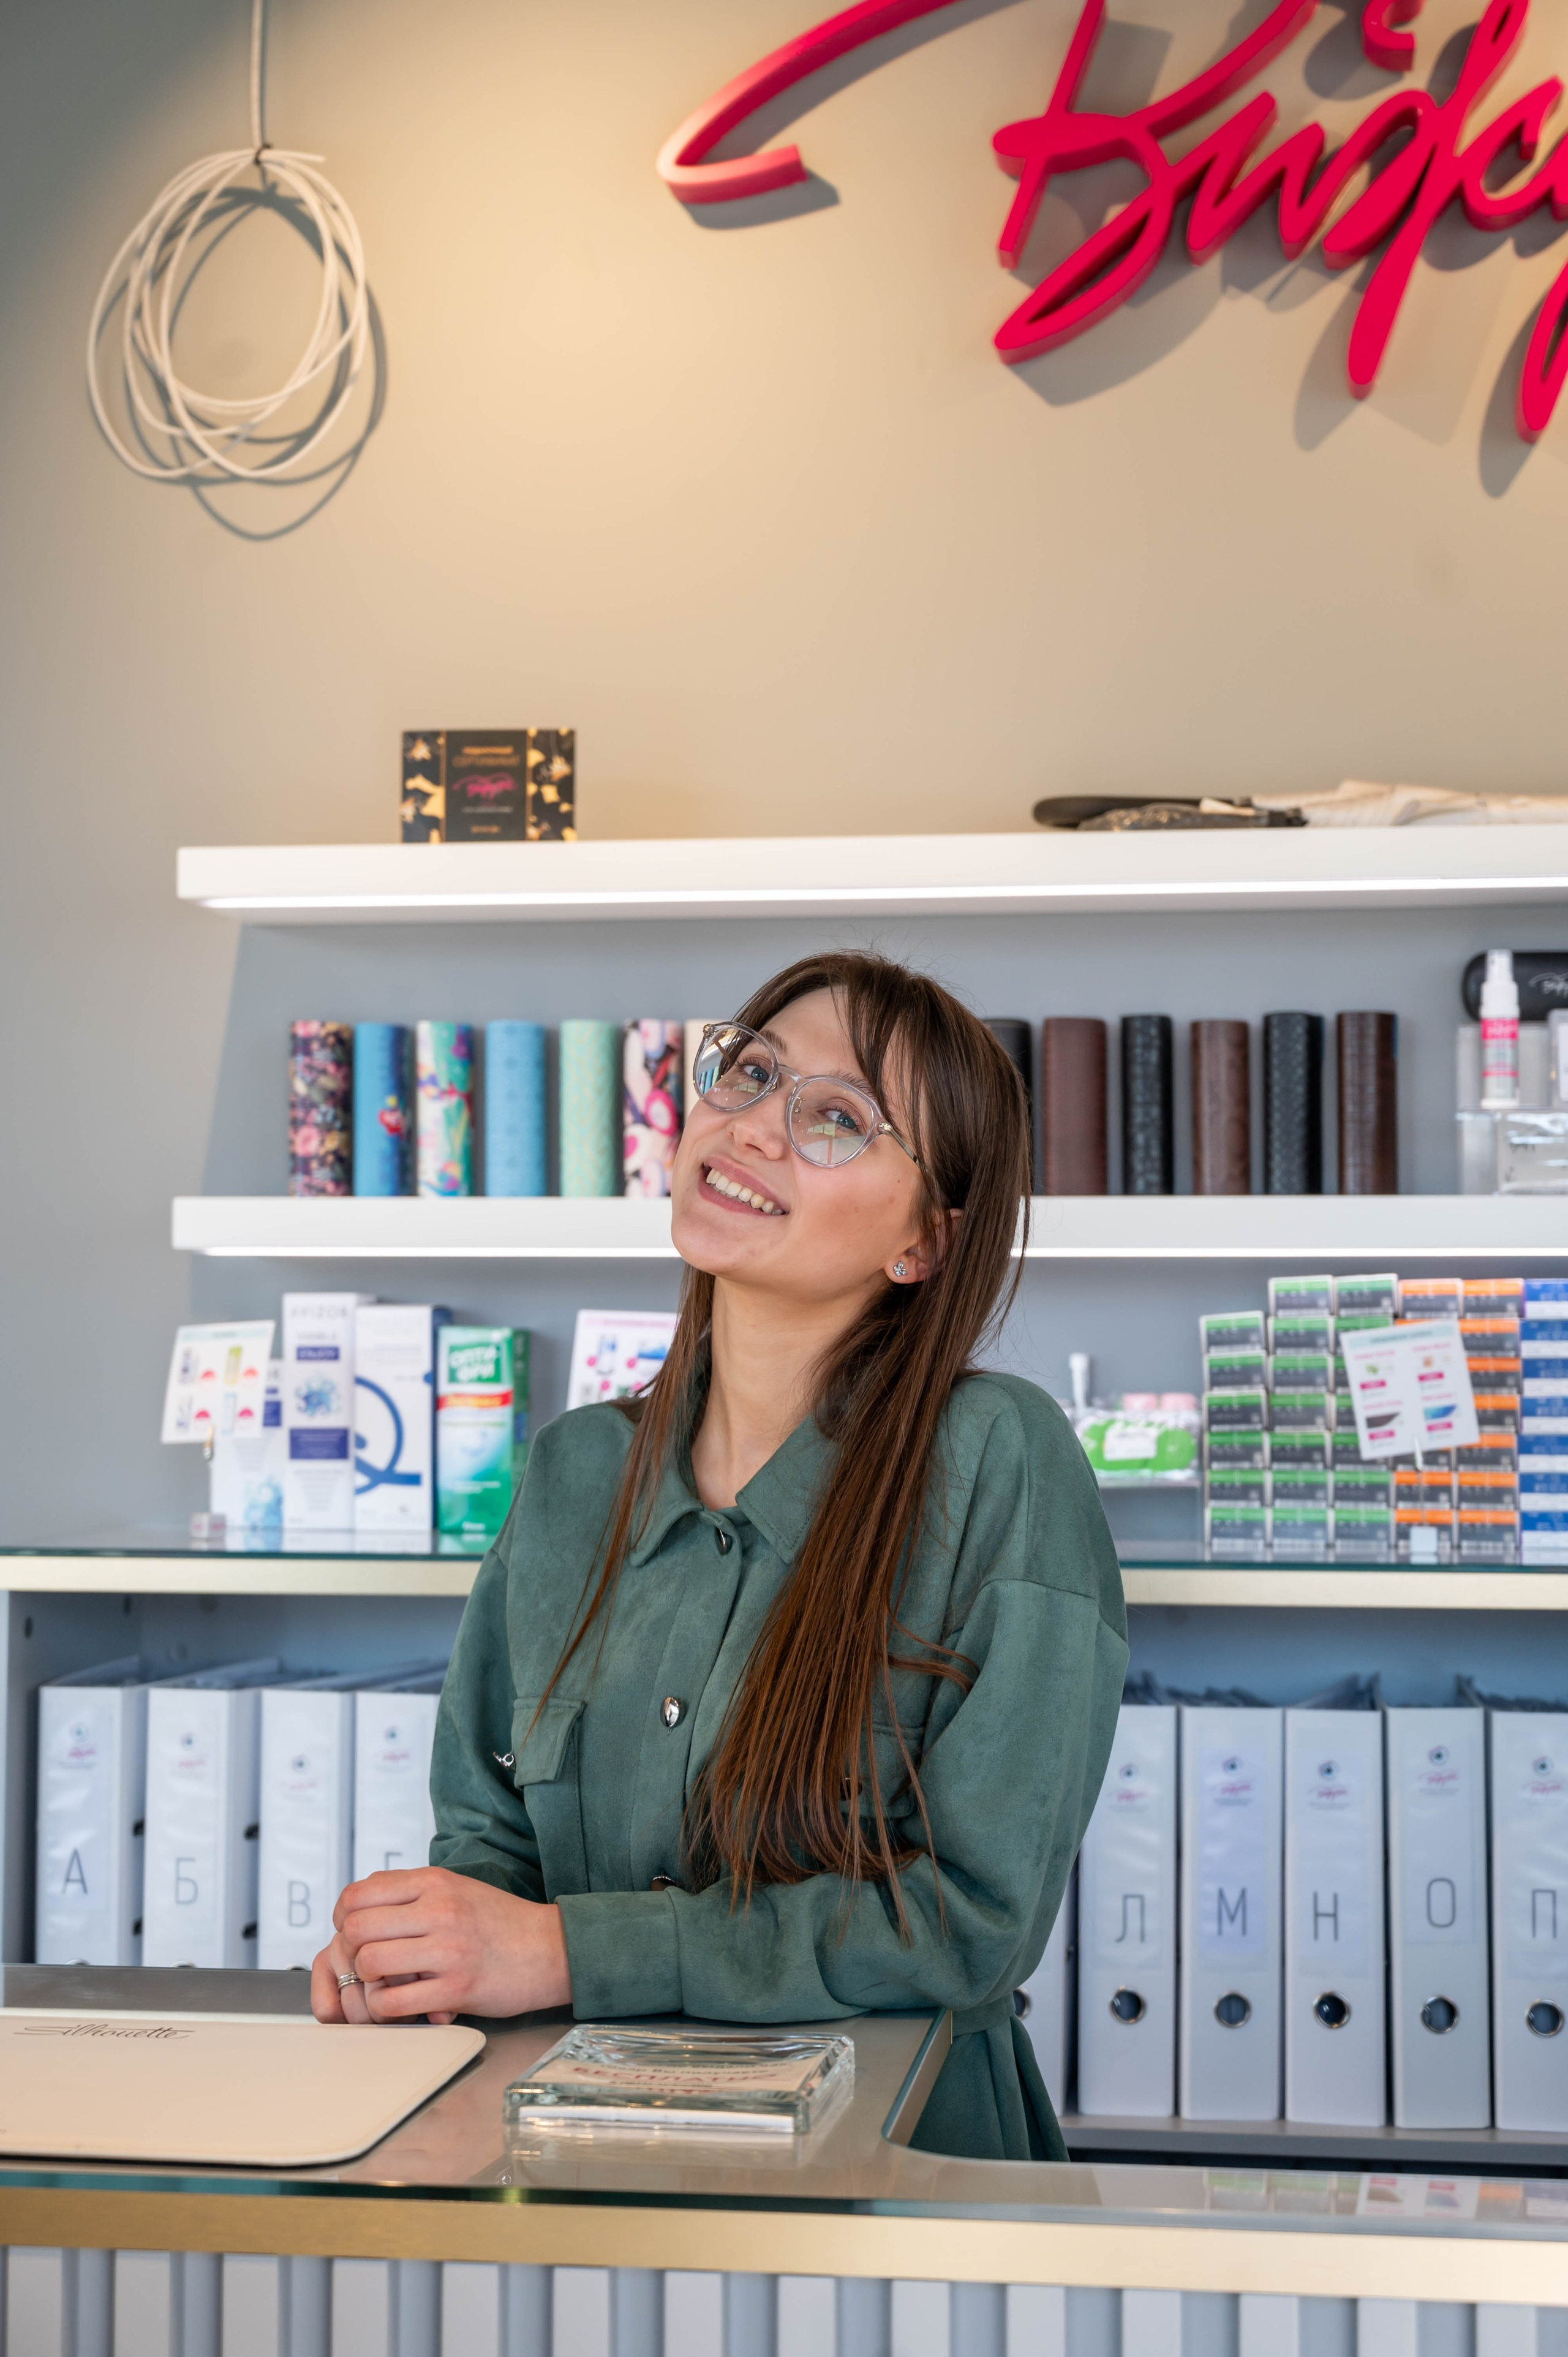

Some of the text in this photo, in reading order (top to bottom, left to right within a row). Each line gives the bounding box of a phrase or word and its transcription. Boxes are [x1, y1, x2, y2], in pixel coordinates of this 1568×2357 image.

[63, 1849, 88, 1894] А
[175, 1858, 198, 1905] Б
[288, 1880, 310, 1926] В
[1115, 1895, 1144, 1943] Л
[1218, 1887, 1246, 1936] М
[1314, 1892, 1338, 1941] Н
[1427, 1878, 1455, 1928] О
[1532, 1889, 1556, 1939] П
[12, 2023, 197, 2040] Silhouette
